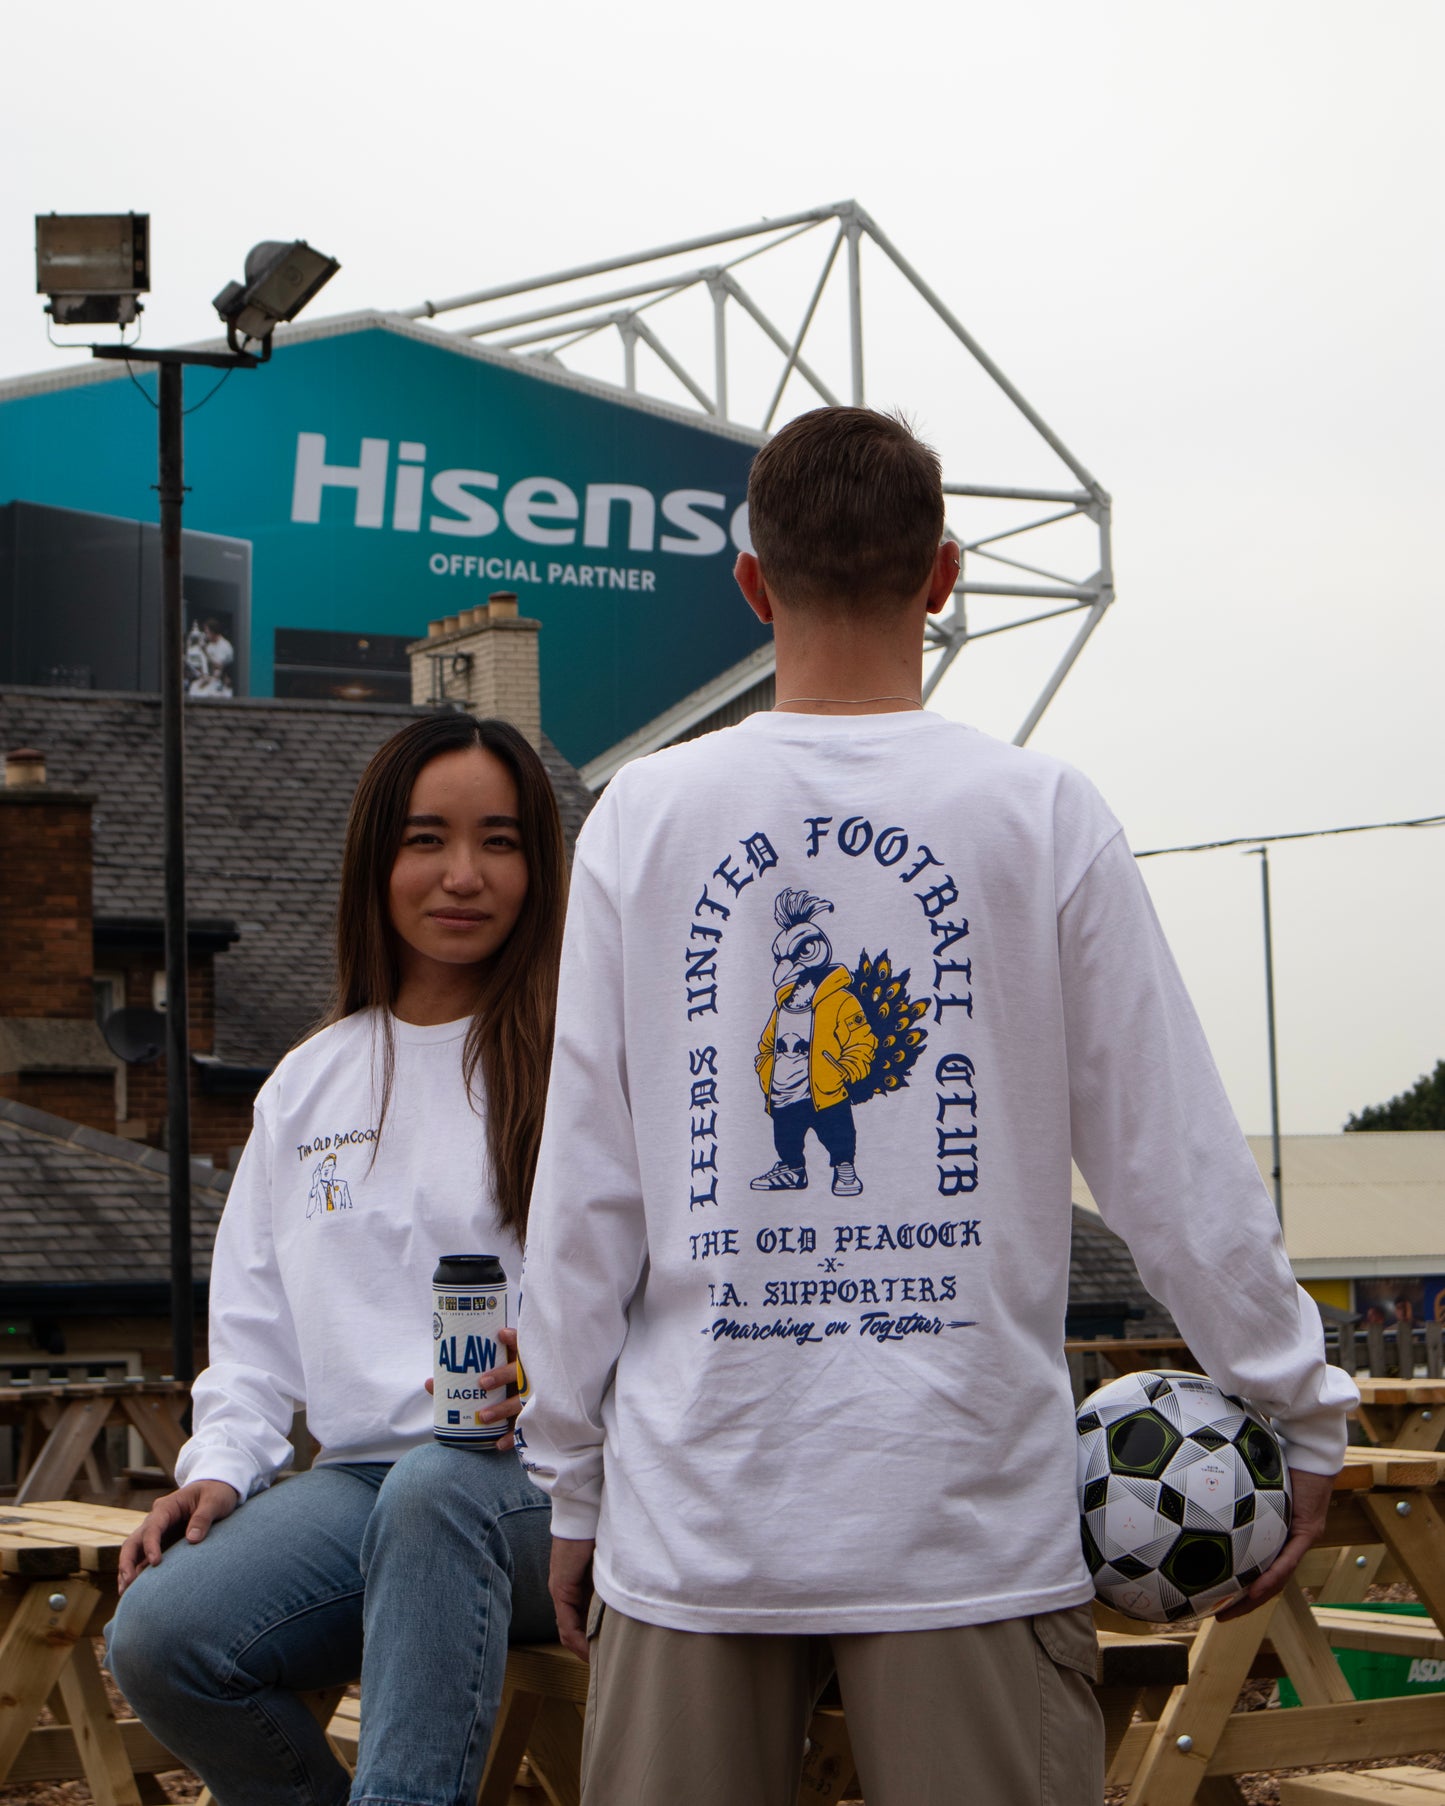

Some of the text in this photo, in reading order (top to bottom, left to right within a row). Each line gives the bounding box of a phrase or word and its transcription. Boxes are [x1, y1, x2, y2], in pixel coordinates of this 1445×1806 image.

[429, 553, 655, 592] OFFICIAL PARTNER
[685, 816, 979, 1212] LEEDS UNITED FOOTBALL CLUB
[689, 1219, 982, 1260] THE OLD PEACOCK
[763, 1275, 957, 1307] SUPPORTERS
[711, 1312, 945, 1347] Marching on Together
[439, 1335, 497, 1373] ALAW
[447, 1388, 488, 1400] LAGER
